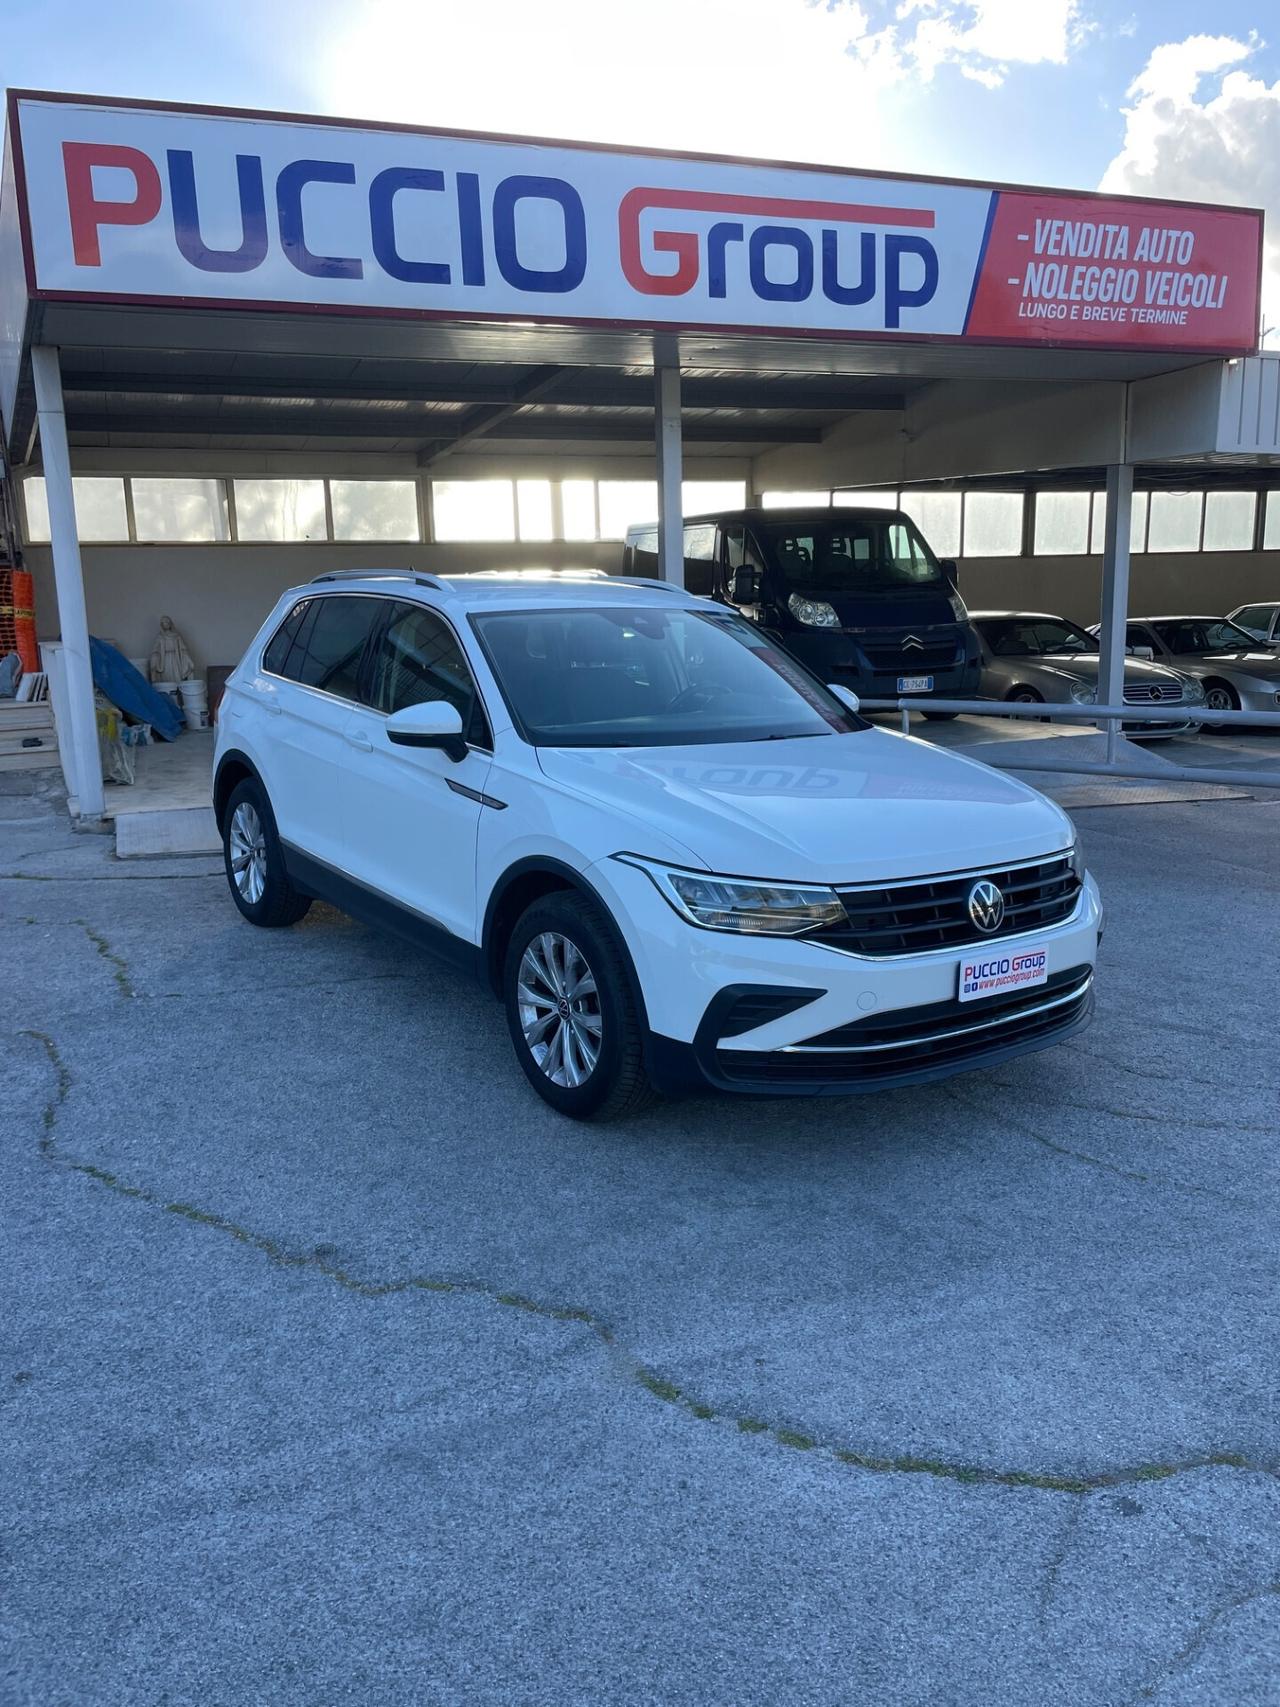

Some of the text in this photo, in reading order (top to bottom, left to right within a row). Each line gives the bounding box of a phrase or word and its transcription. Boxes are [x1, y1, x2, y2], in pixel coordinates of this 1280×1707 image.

[62, 141, 939, 328] PUCCIO Group
[1133, 227, 1195, 266] AUTO
[1144, 270, 1228, 309] VEICOLI
[1018, 302, 1189, 325] LUNGO E BREVE TERMINE
[964, 951, 1046, 982] PUCCIO Group
[979, 967, 1045, 989] www.pucciogroup.com
